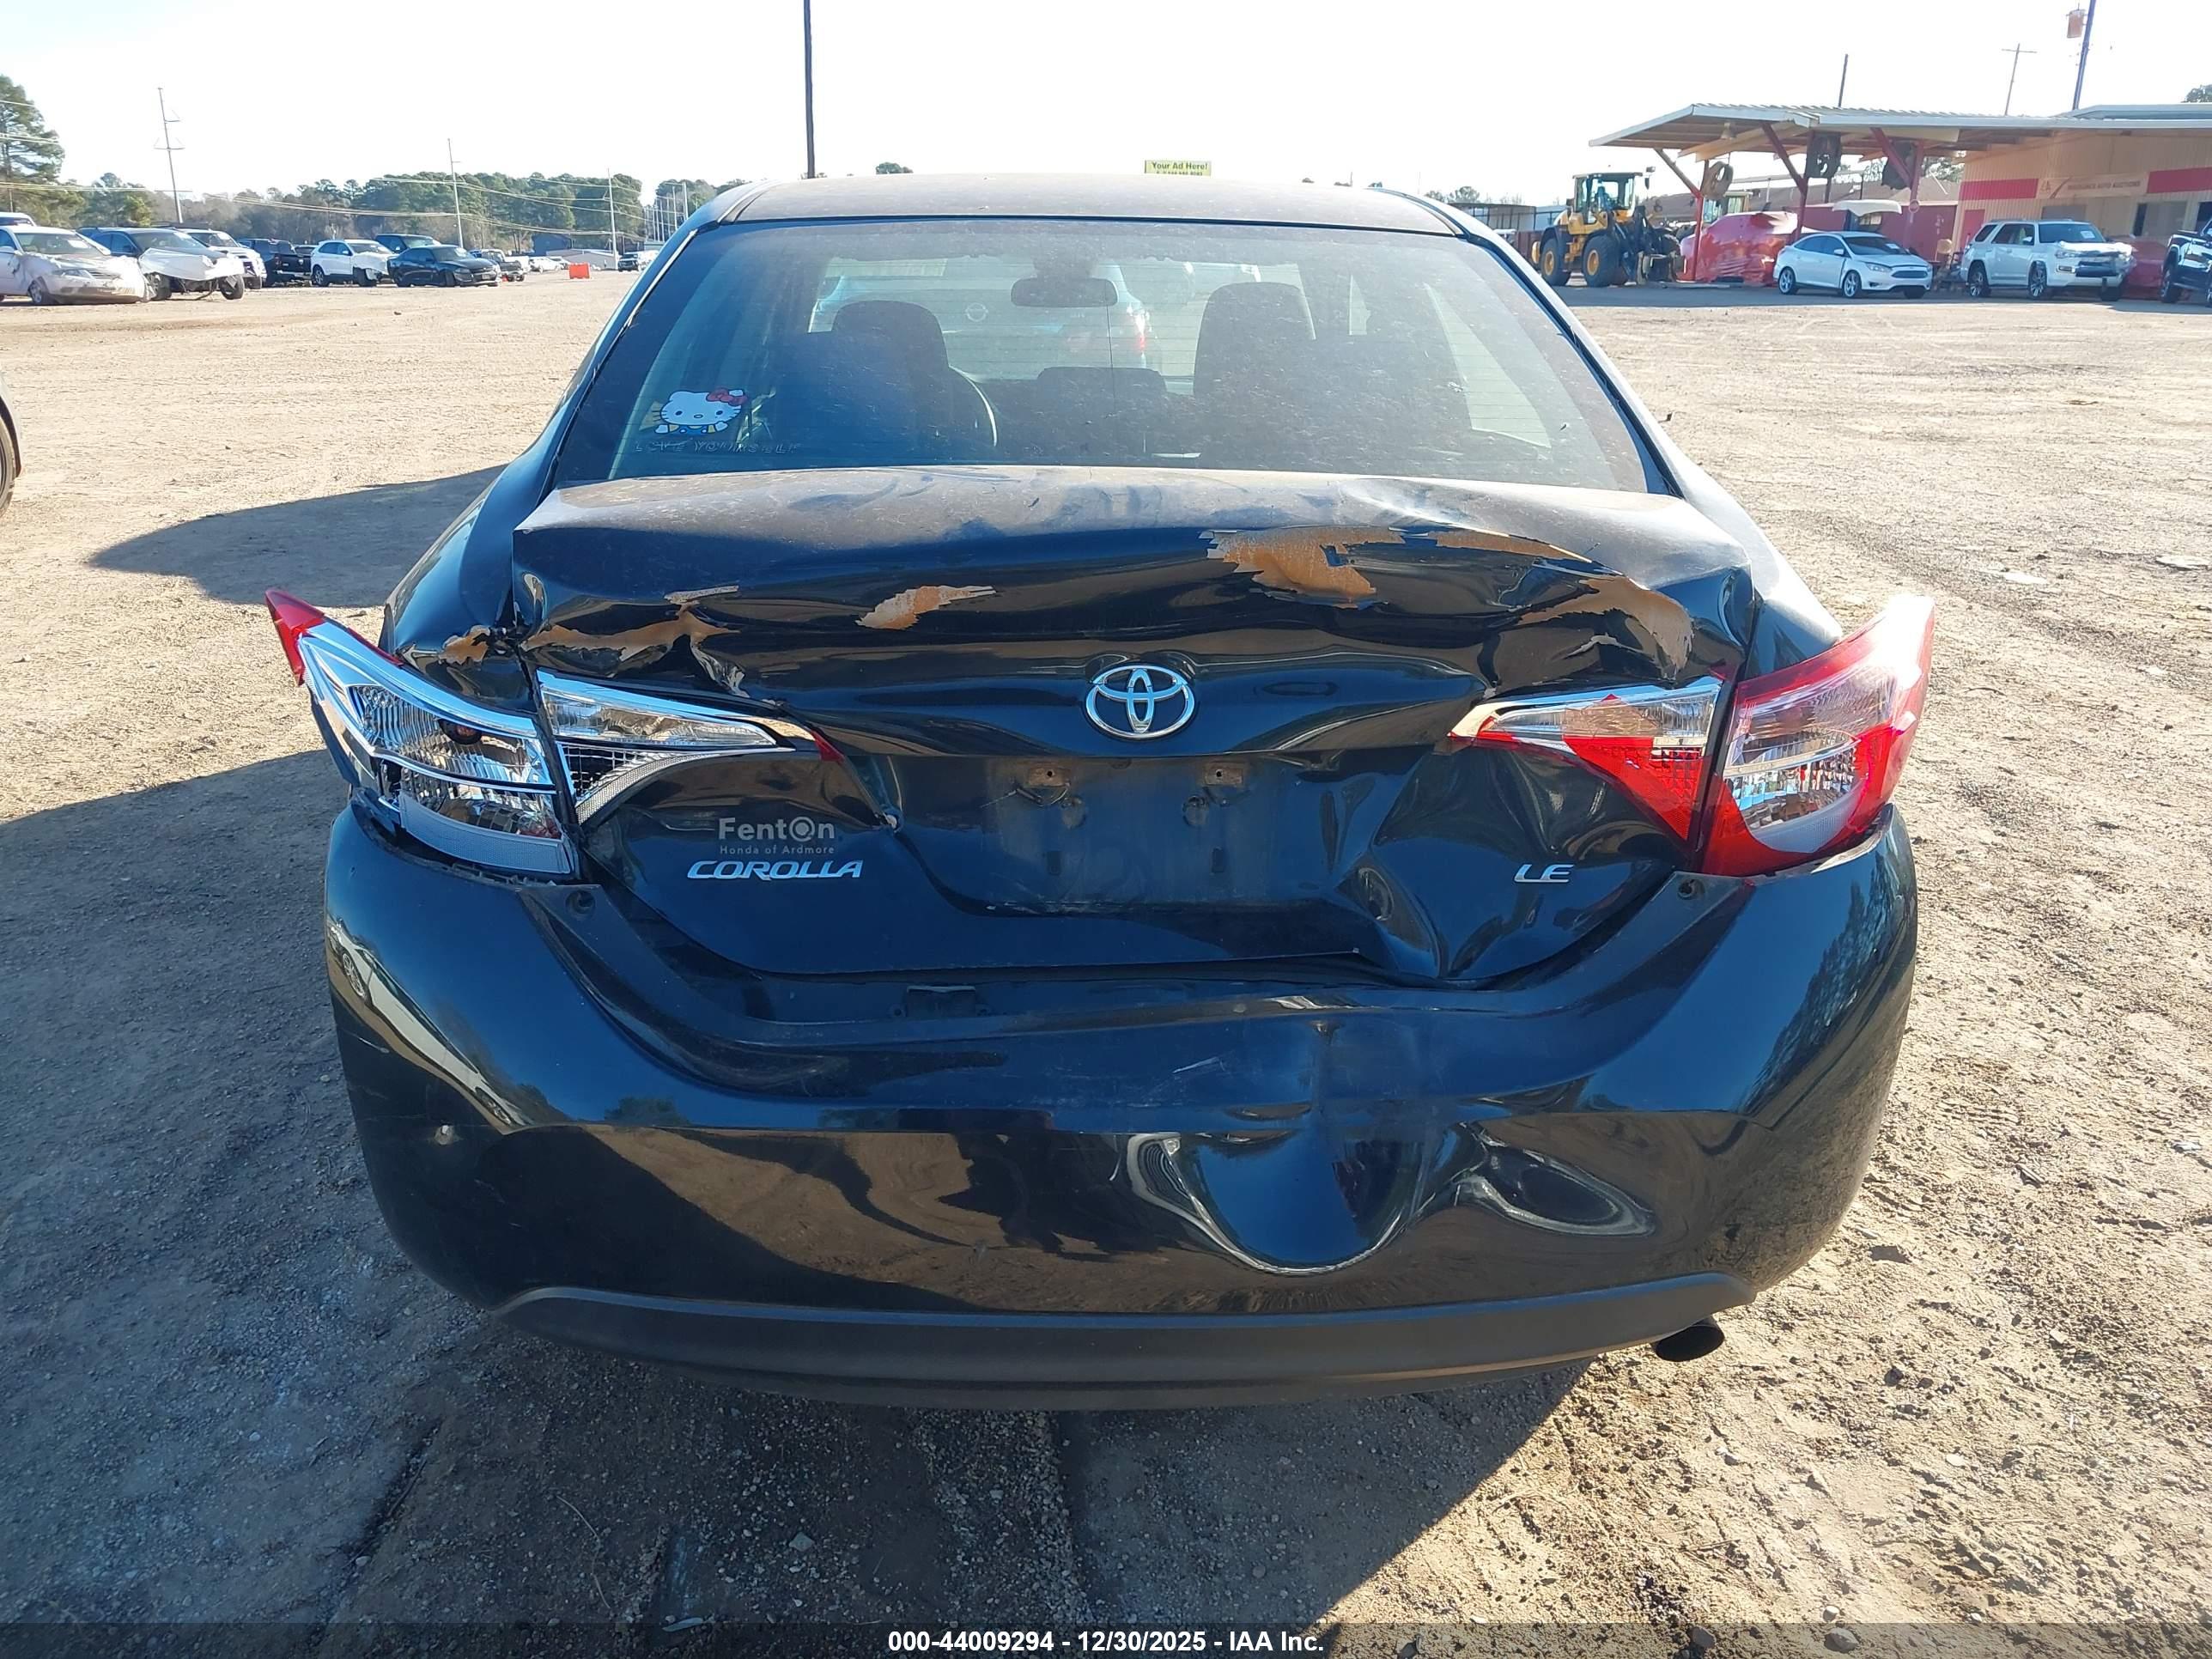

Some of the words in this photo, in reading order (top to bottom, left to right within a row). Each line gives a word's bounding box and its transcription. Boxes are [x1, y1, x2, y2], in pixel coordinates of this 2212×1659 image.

[1186, 161, 1208, 170] Here!
[720, 845, 759, 854] Honda
[764, 845, 776, 854] of
[782, 845, 835, 854] Ardmore
[687, 860, 864, 881] COROLLA
[1514, 864, 1575, 883] LE
